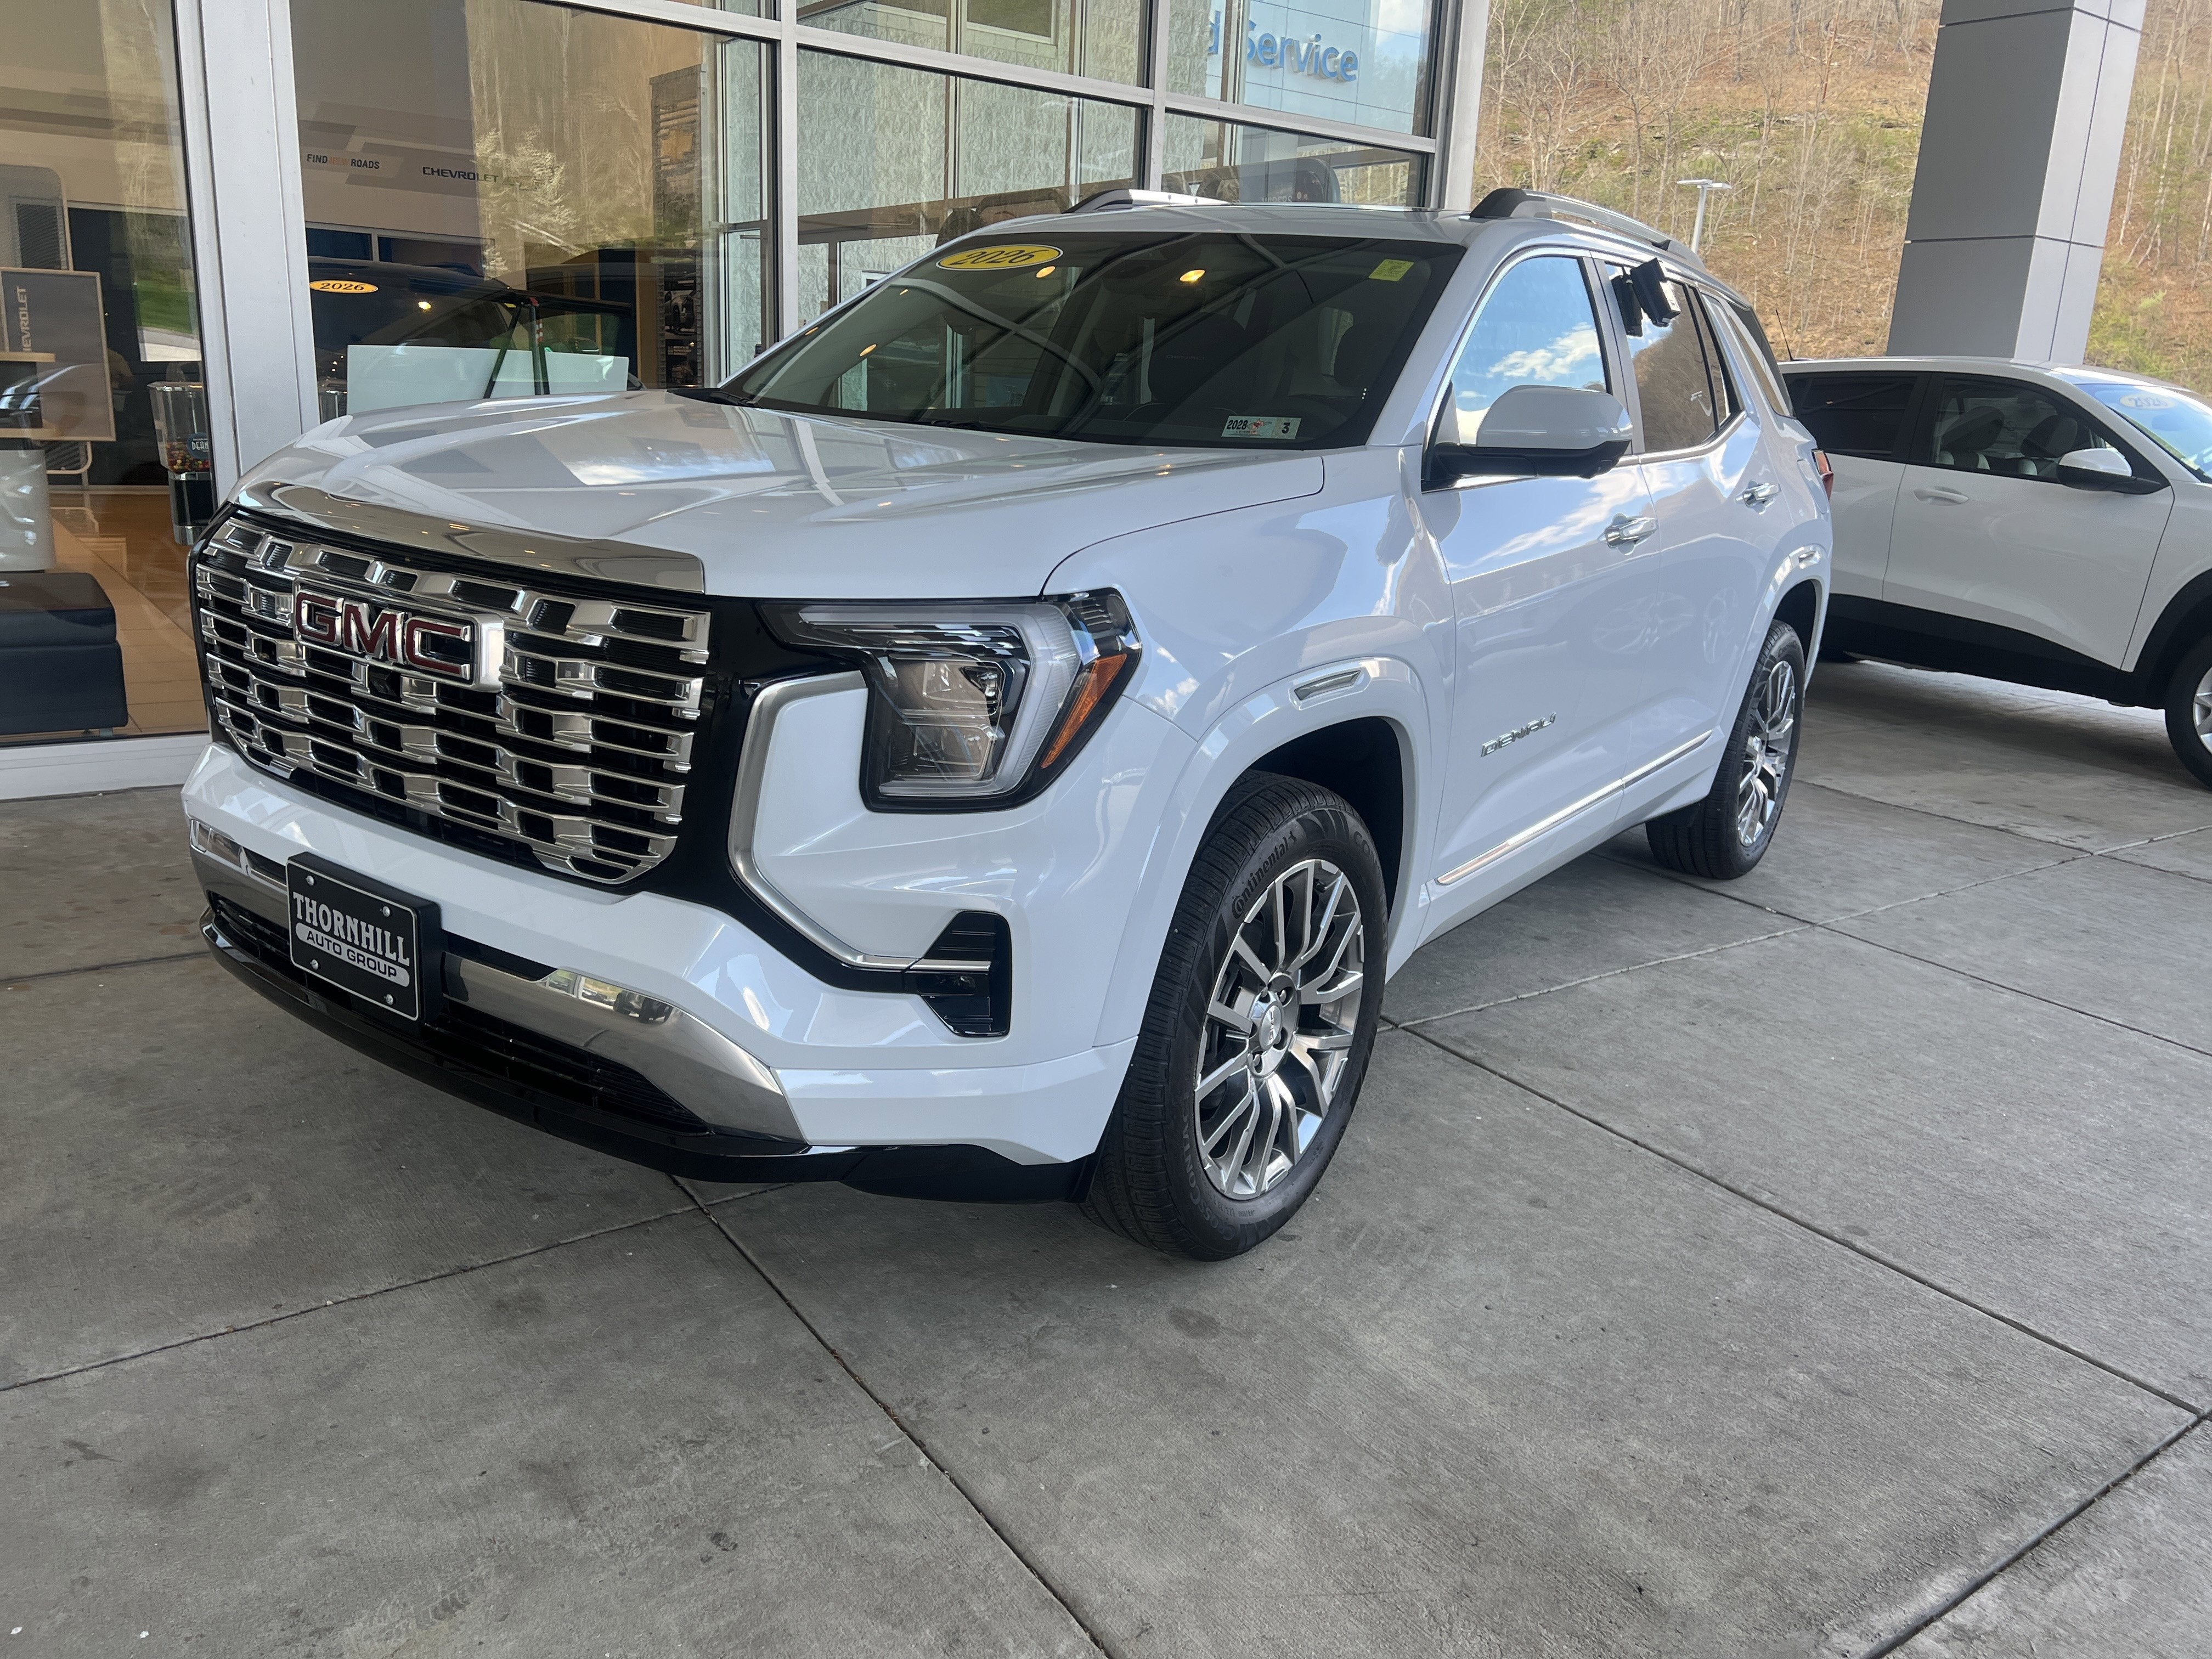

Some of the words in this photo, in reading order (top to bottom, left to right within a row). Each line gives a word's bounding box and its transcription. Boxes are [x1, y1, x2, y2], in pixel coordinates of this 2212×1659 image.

[307, 154, 328, 163] FIND
[351, 158, 380, 170] ROADS
[422, 166, 499, 183] CHEVROLET
[947, 249, 1049, 266] 2026
[319, 282, 365, 291] 2026
[16, 286, 32, 352] EVROLET
[1226, 420, 1249, 430] 2028
[1281, 422, 1291, 434] 3
[296, 589, 471, 681] GMC
[1481, 712, 1557, 758] DENALI
[1232, 836, 1289, 919] Continental
[293, 891, 410, 967] THORNHILL
[306, 930, 342, 956] AUTO
[347, 948, 397, 979] GROUP
